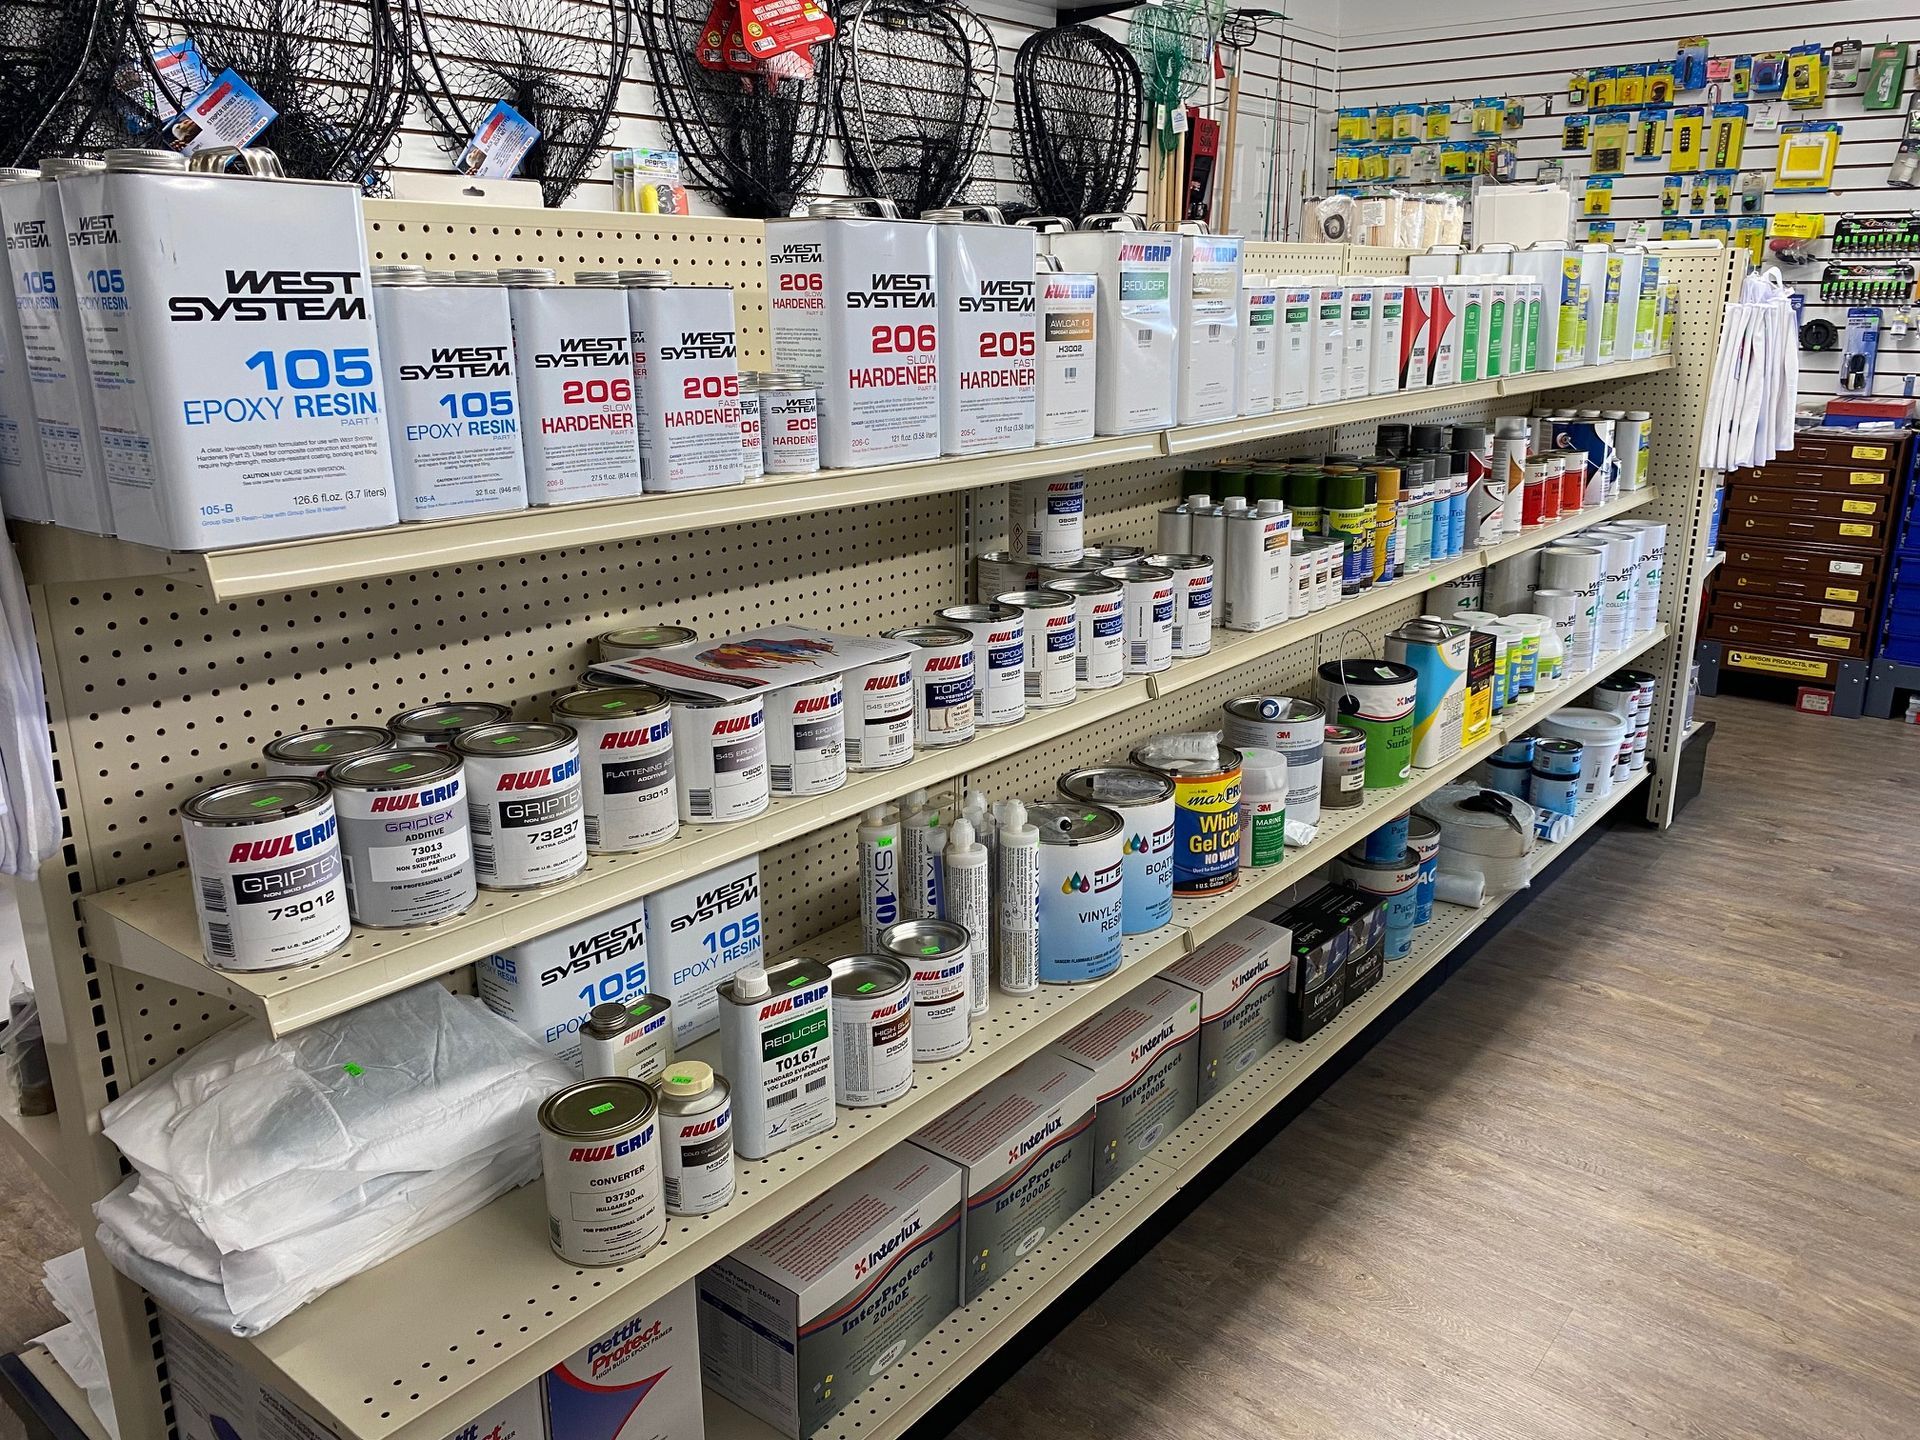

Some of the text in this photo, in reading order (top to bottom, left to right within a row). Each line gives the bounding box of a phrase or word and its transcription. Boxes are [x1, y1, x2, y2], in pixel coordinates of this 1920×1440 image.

[14, 221, 46, 235] WEST
[79, 215, 114, 231] WEST
[7, 235, 49, 250] SYSTEM
[68, 230, 118, 246] SYSTEM
[783, 243, 821, 253] WEST
[770, 254, 823, 264] SYSTEM
[1118, 245, 1171, 262] AWLGRIP
[1192, 247, 1238, 262] AWLGRIP
[23, 271, 56, 293] 105
[87, 270, 125, 293] 105
[225, 270, 361, 295] WEST
[780, 273, 823, 291] 206
[872, 274, 934, 290] WEST
[981, 280, 1035, 295] WEST
[1044, 284, 1096, 299] AWLGRIP
[1122, 280, 1165, 292] REDUCER
[168, 297, 367, 322] SYSTEM
[772, 298, 824, 309] HARDENER
[847, 292, 936, 308] SYSTEM
[959, 297, 1035, 312] SYSTEM
[1050, 318, 1082, 329] AWLCAT
[560, 337, 627, 352] WEST
[682, 332, 736, 345] WEST
[871, 325, 936, 353] 206
[980, 332, 1035, 358] 205
[1058, 344, 1083, 353] H3002
[431, 347, 508, 363] WEST
[535, 352, 629, 368] SYSTEM
[661, 347, 736, 360] SYSTEM
[907, 355, 936, 365] SLOW
[1014, 358, 1035, 368] FAST
[245, 348, 373, 391] 105
[400, 363, 510, 380] SYSTEM
[849, 366, 936, 389] HARDENER
[960, 369, 1035, 390] HARDENER
[562, 379, 632, 404] 206
[684, 376, 739, 400] 205
[184, 391, 378, 426] EPOXY RESIN
[439, 391, 514, 418] 105
[602, 404, 633, 412] SLOW
[718, 399, 739, 407] FAST
[771, 406, 816, 414] SYSTEM
[786, 398, 815, 407] WEST
[541, 413, 634, 434] HARDENER
[665, 408, 740, 428] HARDENER
[787, 418, 817, 431] 205
[406, 419, 516, 441] EPOXY RESIN
[772, 435, 817, 445] HARDENER
[242, 472, 270, 480] CAUTION
[293, 487, 388, 506] 126.6 fl.oz. (3.7 liters)
[1048, 481, 1083, 492] AWLGRIP
[414, 495, 436, 503] 105-A
[199, 503, 235, 517] 105-B
[1264, 519, 1290, 533] AWLGRIP
[1744, 655, 1771, 663] LAWSON
[1772, 658, 1807, 668] PRODUCTS,
[1276, 731, 1291, 739] 3M
[370, 780, 460, 813] AWLGRIP
[506, 787, 582, 819] GRIPTEX
[638, 787, 669, 803] G3013
[1199, 801, 1238, 834] White
[1256, 803, 1271, 812] 3M
[523, 816, 540, 824] NON
[540, 812, 555, 822] SKID
[1256, 815, 1282, 826] MARINE
[228, 814, 338, 864] AWLGRIP
[405, 826, 445, 843] ADDITIVE
[526, 819, 580, 845] 73237
[411, 841, 443, 856] 73013
[1189, 834, 1218, 854] Gel
[396, 853, 457, 873] NON SKID PARTICLES
[415, 852, 441, 864] GRIPTEX
[1204, 849, 1237, 865] NO WAX
[242, 851, 341, 895] GRIPTEX
[263, 872, 334, 899] NON SKID PARTICLES
[390, 884, 403, 892] FOR
[403, 877, 443, 891] PROFESSIONAL
[696, 872, 758, 909] WEST
[874, 848, 898, 925] Six10
[267, 889, 336, 922] 73012
[670, 886, 759, 934] SYSTEM
[569, 917, 643, 960] WEST
[702, 912, 760, 954] 105
[488, 955, 517, 974] 105
[541, 931, 645, 988] SYSTEM
[673, 934, 761, 987] EPOXY RESIN
[913, 962, 965, 981] AWLGRIP
[1238, 957, 1270, 987] Interlux
[578, 960, 646, 1008] 105
[916, 981, 964, 997] HIGH BUILD
[758, 984, 830, 1022] AWLGRIP
[927, 1005, 956, 1018] D3002
[1222, 986, 1276, 1032] InterProtect
[763, 1022, 773, 1030] FOR
[772, 1013, 800, 1029] PROFESSIONAL
[1238, 1007, 1262, 1031] 2000E
[623, 1015, 667, 1046] AWLGRIP
[763, 1018, 828, 1051] REDUCER
[1138, 1022, 1176, 1059] Interlux
[635, 1041, 658, 1057] CONVERTER
[775, 1046, 819, 1073] T0167
[763, 1055, 831, 1087] STANDARD EVAPORATING
[766, 1063, 829, 1092] VOC EXEMPT REDUCER
[1121, 1052, 1184, 1109] InterProtect
[1140, 1078, 1167, 1106] 2000E
[568, 1123, 656, 1163] AWLGRIP
[1018, 1115, 1064, 1156] Interlux
[590, 1163, 646, 1188] CONVERTER
[994, 1149, 1073, 1214] InterProtect
[605, 1188, 636, 1204] D3730
[1018, 1177, 1052, 1209] 2000E
[595, 1193, 645, 1214] HULLGARD EXTRA
[594, 1219, 637, 1234] PROFESSIONAL
[636, 1215, 646, 1226] USE
[867, 1217, 923, 1269] Interlux
[841, 1250, 934, 1336] InterProtect
[872, 1286, 911, 1325] 2000E
[587, 1316, 642, 1366] Pettit
[591, 1319, 662, 1378] Protect
[595, 1326, 674, 1381] HIGH BUILD EPOXY PRIMER
